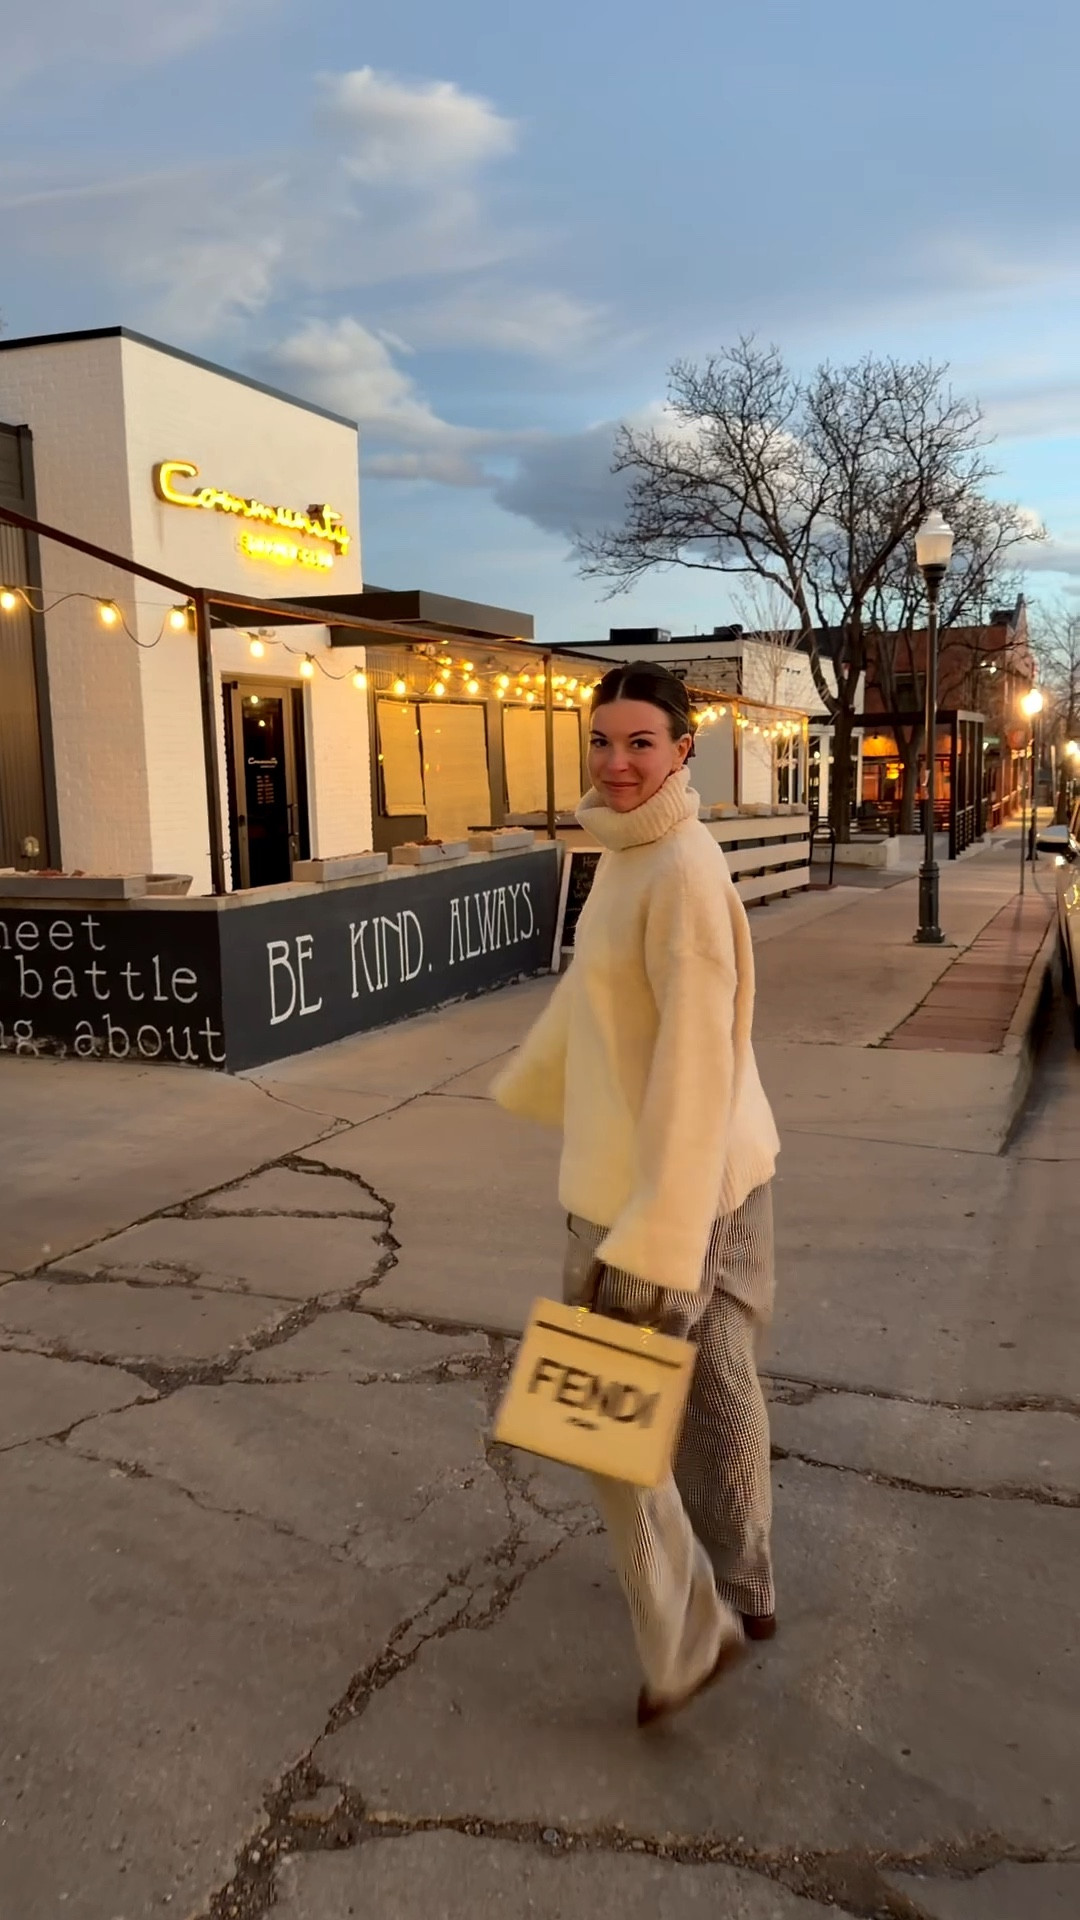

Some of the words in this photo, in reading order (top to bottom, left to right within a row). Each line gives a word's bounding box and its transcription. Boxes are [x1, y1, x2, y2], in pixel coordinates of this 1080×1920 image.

[14, 954, 199, 1003] battle
[266, 934, 322, 1026] BE
[349, 910, 433, 998] KIND.
[448, 882, 540, 965] ALWAYS.
[74, 1013, 227, 1062] about
